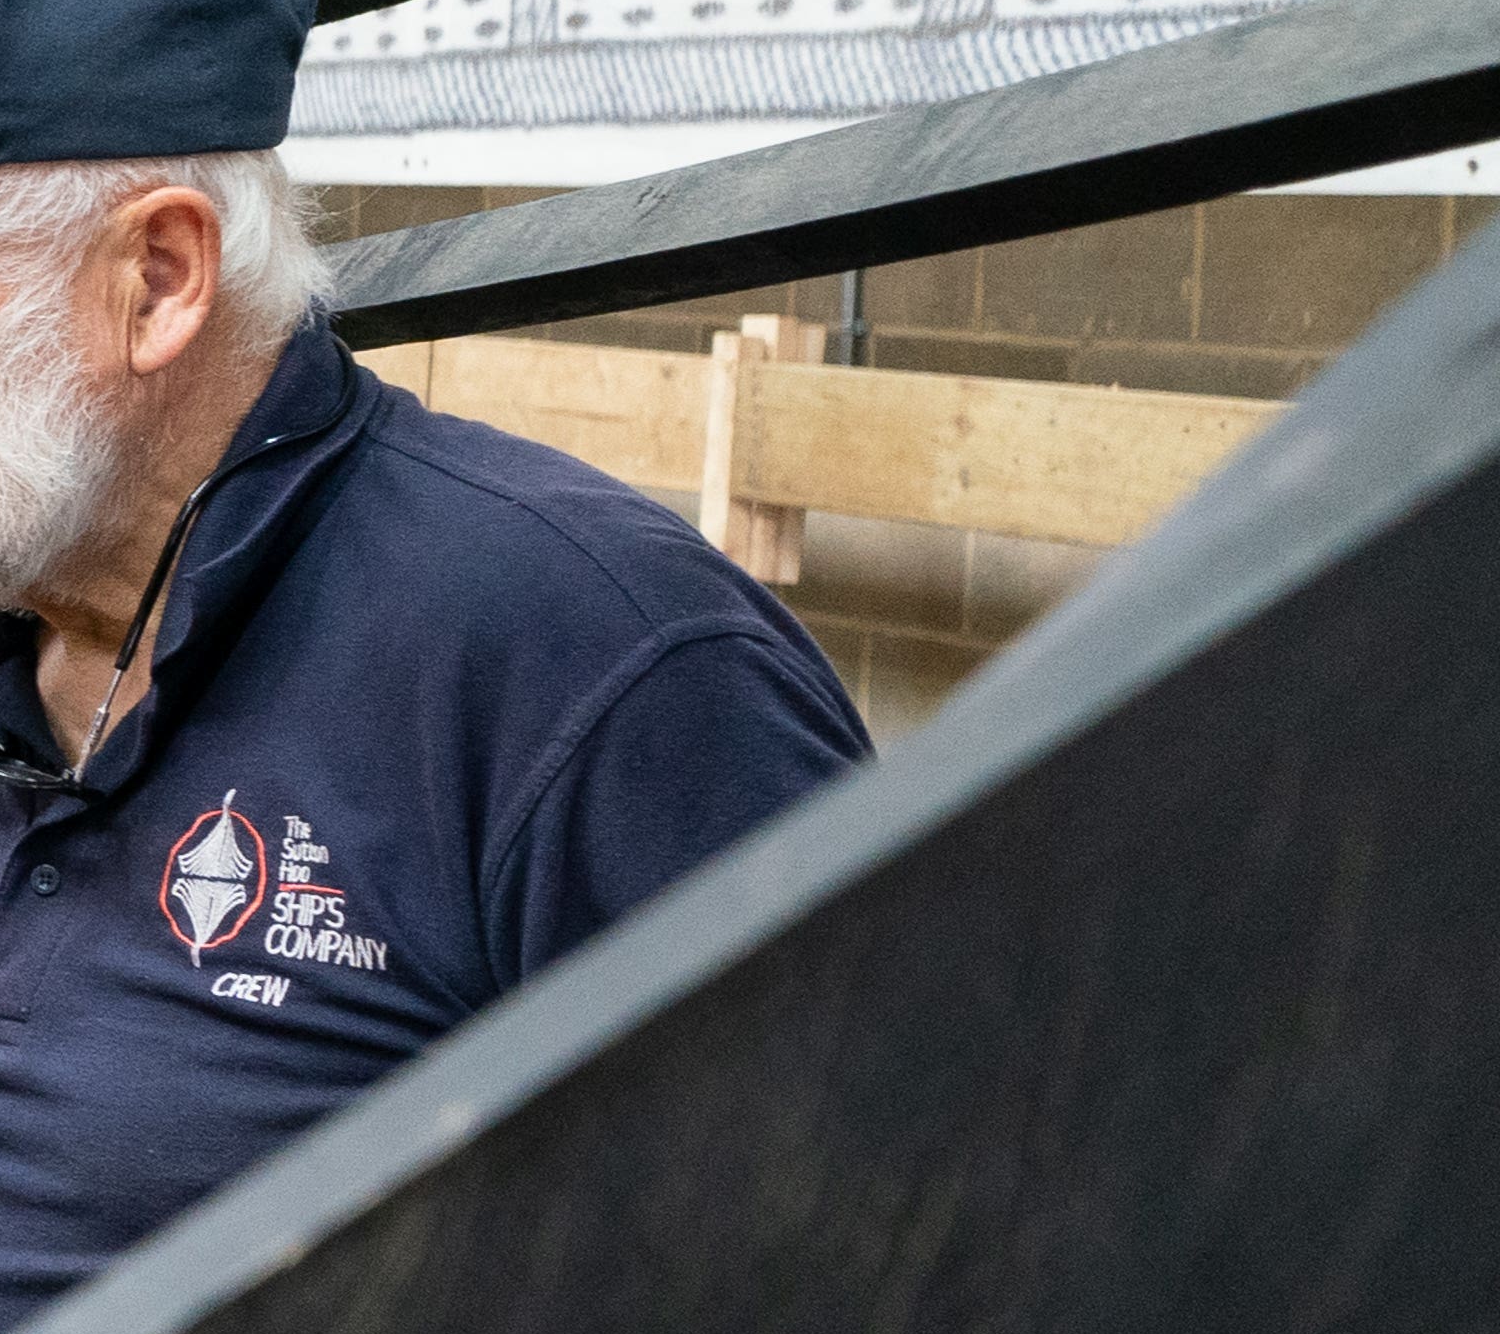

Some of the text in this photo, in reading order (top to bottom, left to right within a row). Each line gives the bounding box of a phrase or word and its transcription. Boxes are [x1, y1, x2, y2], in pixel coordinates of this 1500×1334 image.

[283, 815, 312, 839] The
[280, 837, 330, 864] Sutton
[278, 863, 311, 883] Hoo
[271, 892, 346, 928] SHIP'S
[263, 923, 388, 971] COMPANY
[210, 971, 291, 1008] CREW
